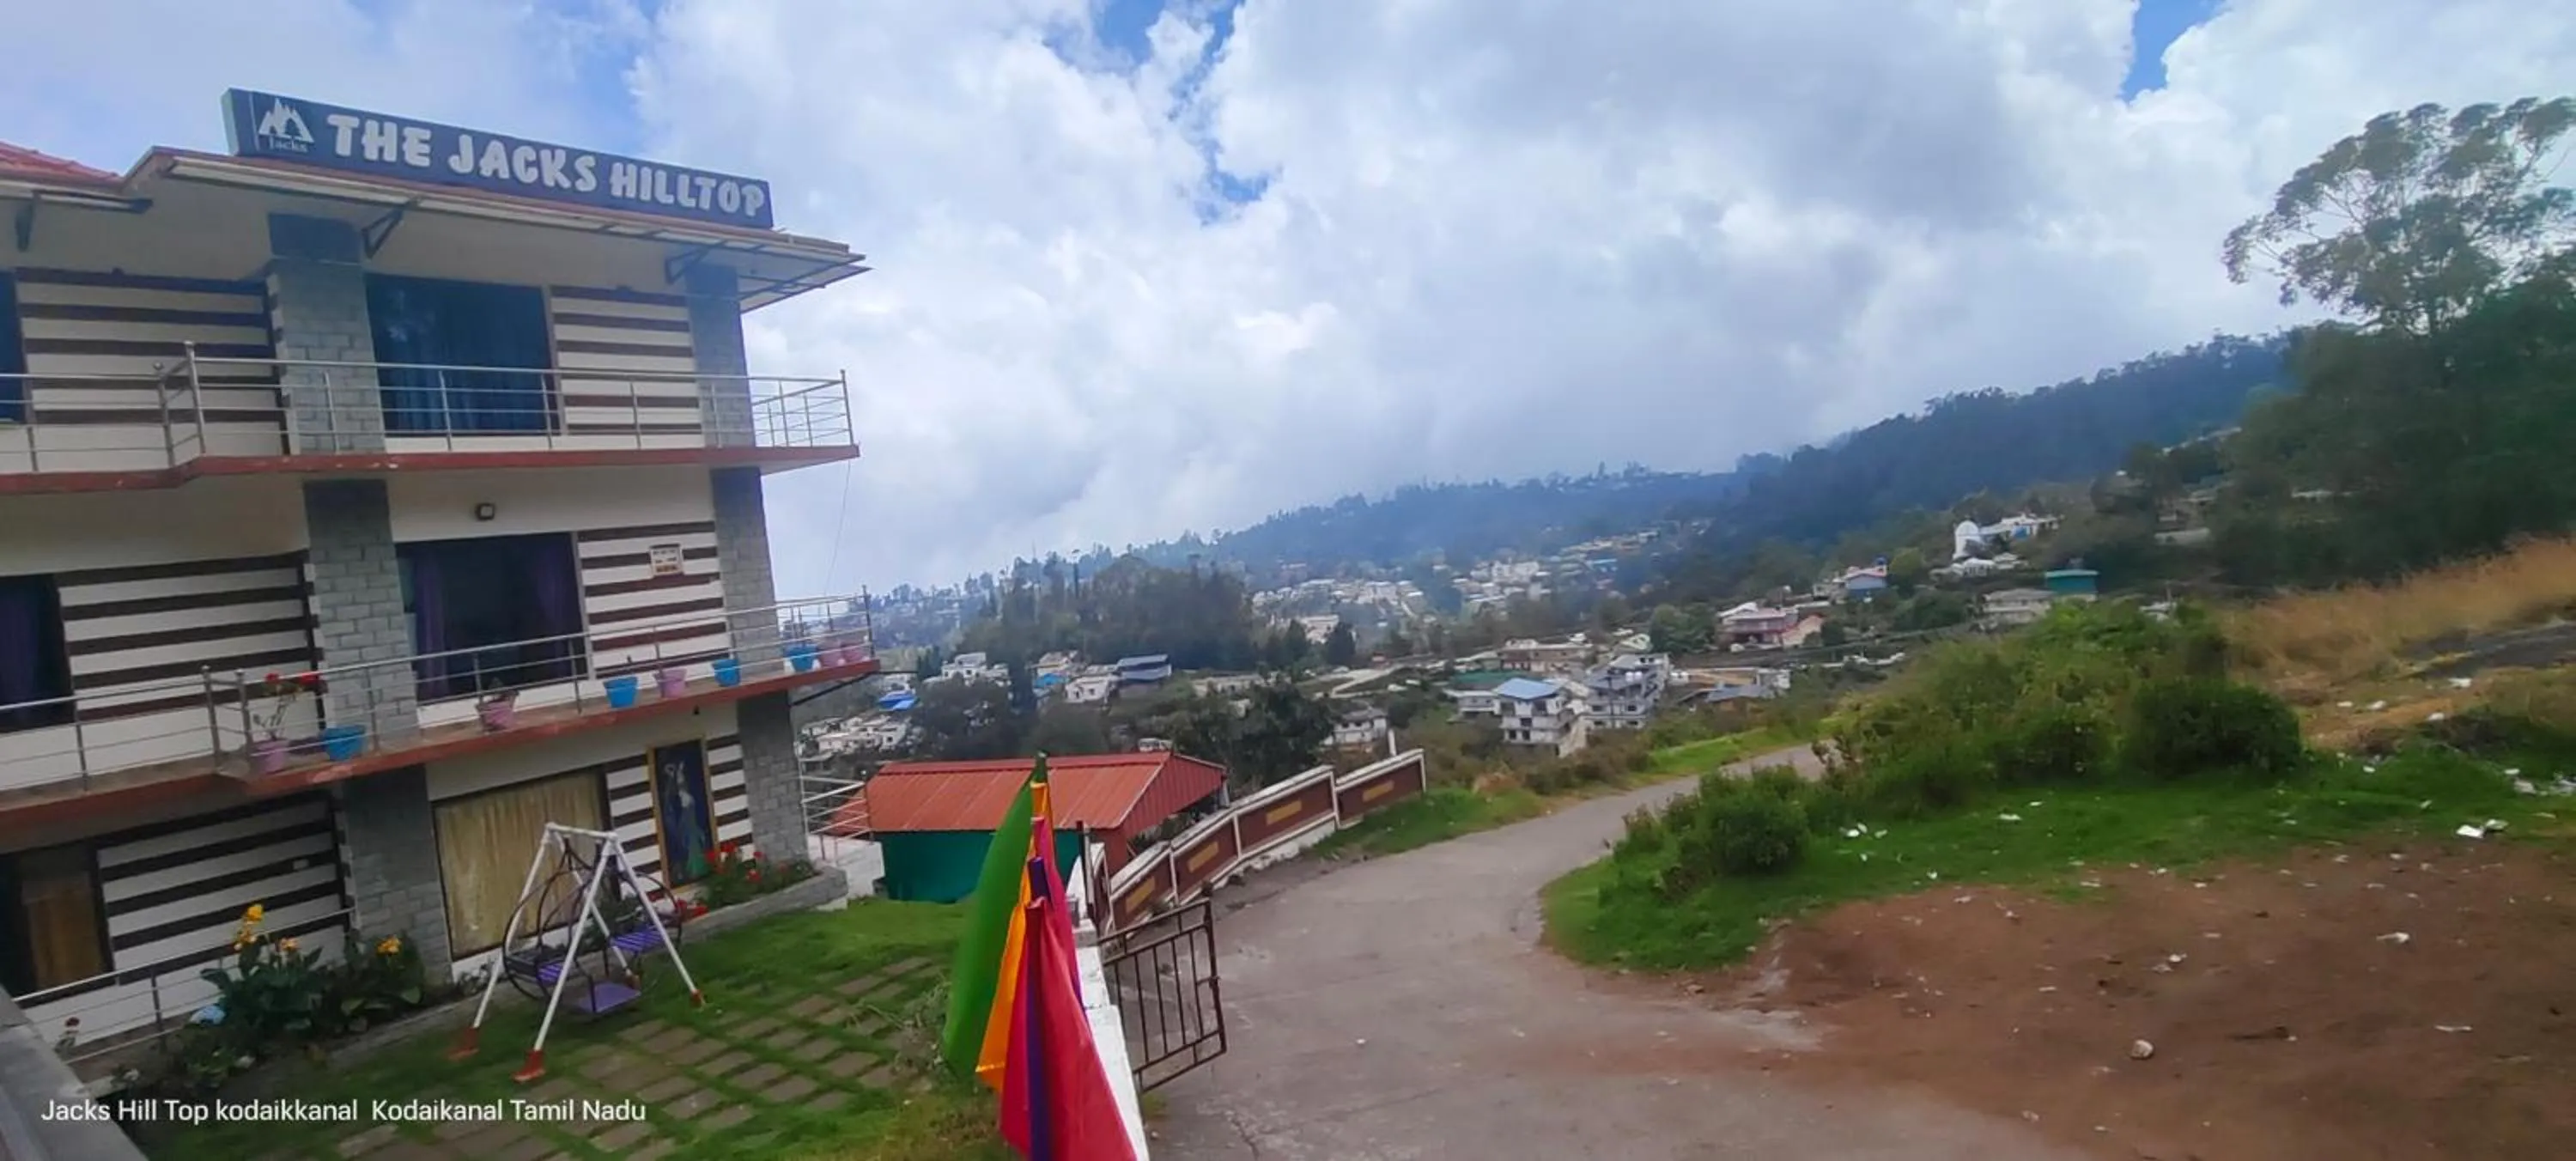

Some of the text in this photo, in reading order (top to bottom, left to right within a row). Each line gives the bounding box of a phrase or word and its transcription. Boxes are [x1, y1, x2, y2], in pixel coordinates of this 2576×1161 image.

[268, 136, 308, 153] Jacks
[327, 114, 766, 216] THE JACKS HILLTOP
